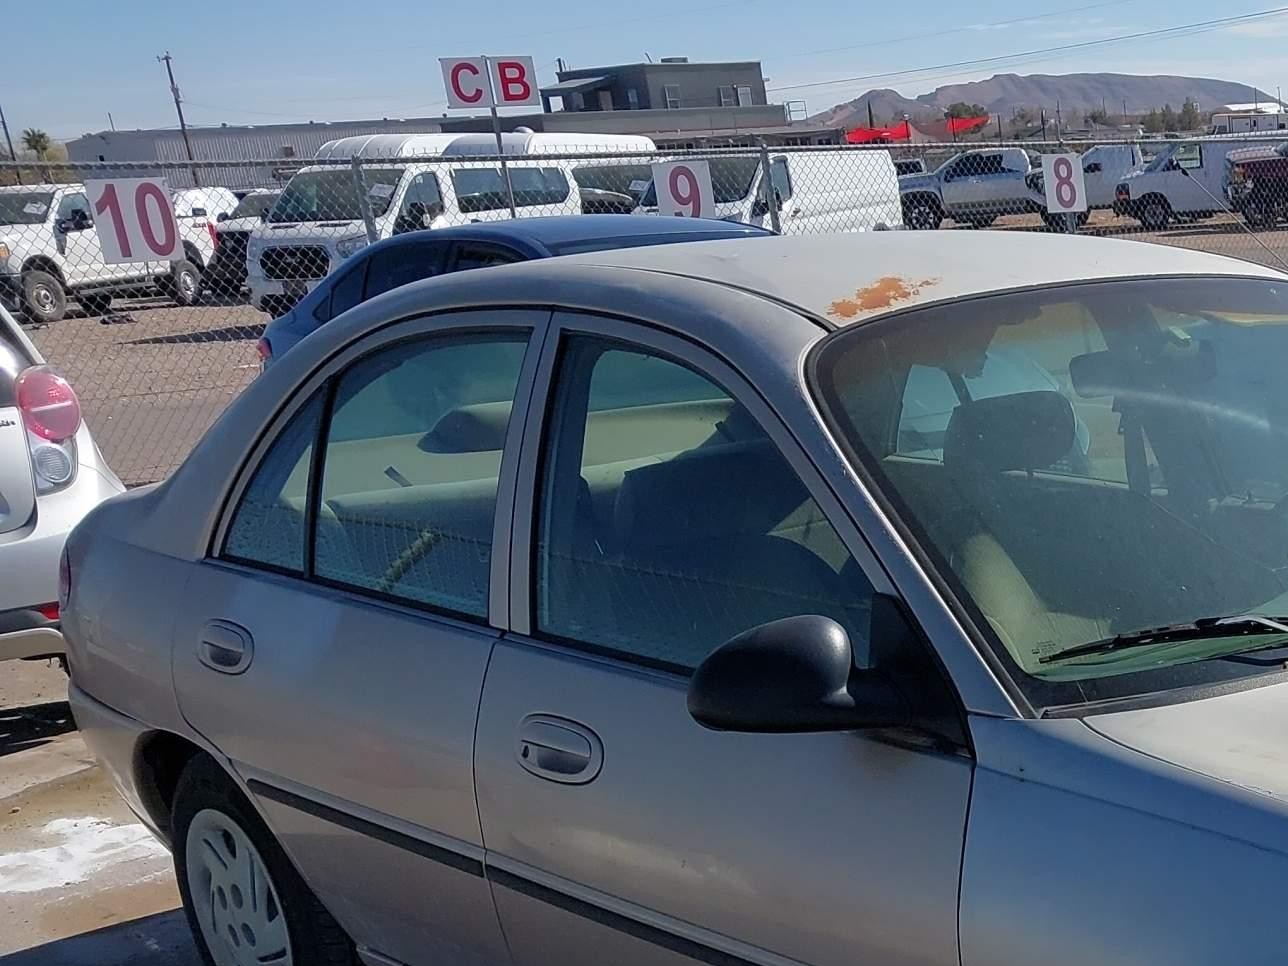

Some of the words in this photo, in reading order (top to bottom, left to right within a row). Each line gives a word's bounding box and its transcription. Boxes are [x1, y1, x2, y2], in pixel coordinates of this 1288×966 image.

[451, 62, 483, 103] C
[497, 62, 531, 102] B
[669, 165, 701, 218] 9
[1053, 157, 1077, 208] 8
[95, 182, 176, 258] 10
